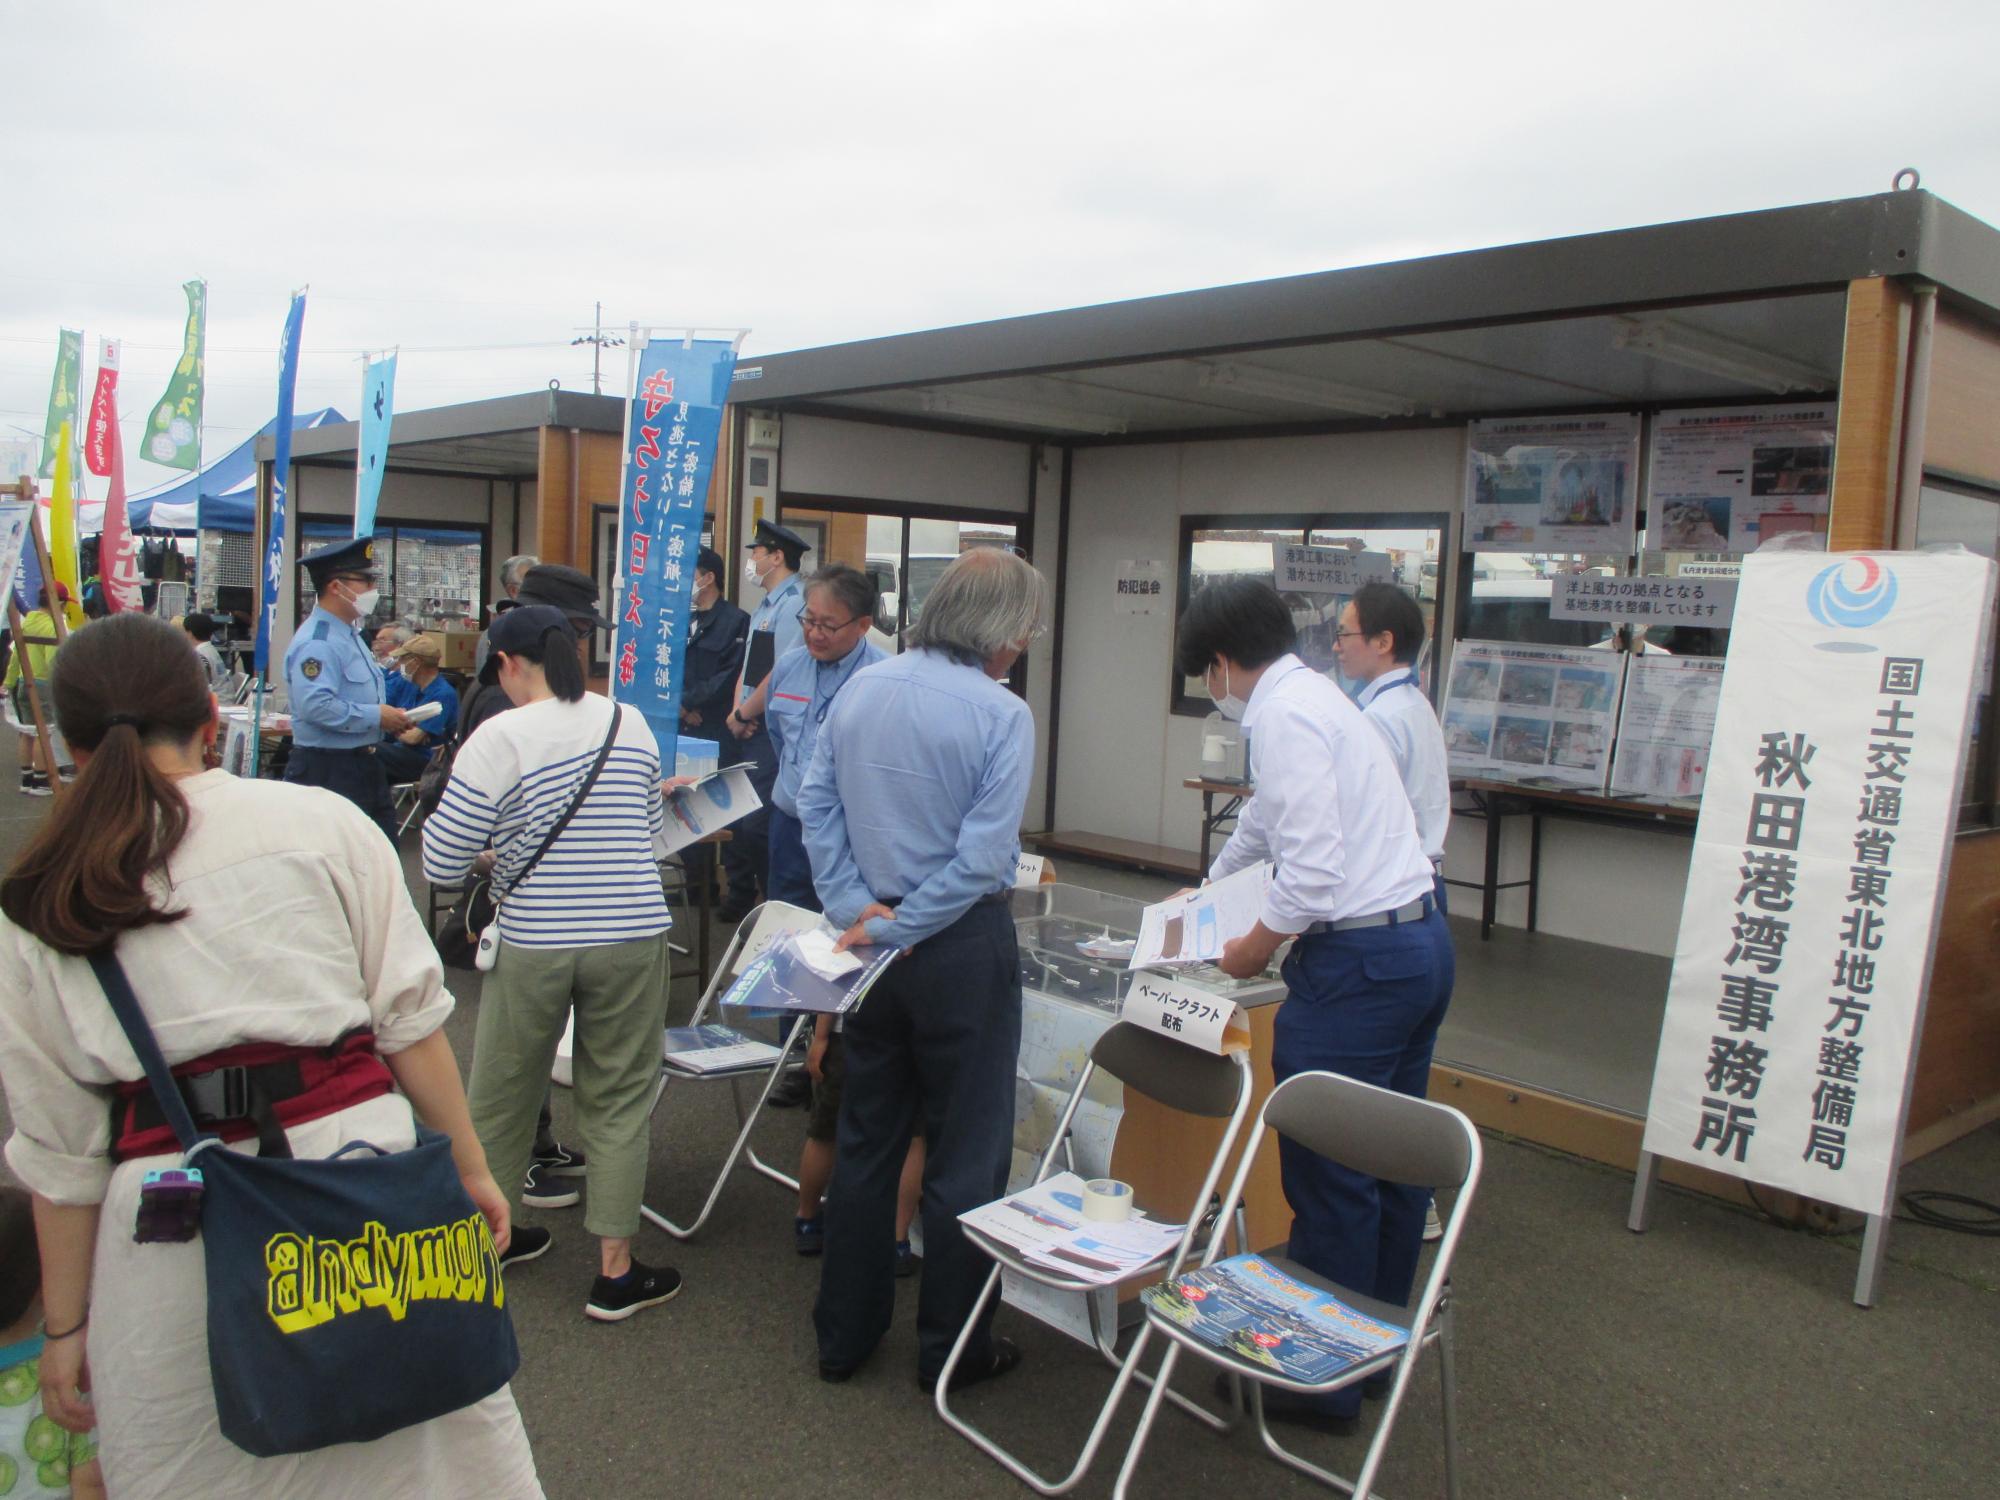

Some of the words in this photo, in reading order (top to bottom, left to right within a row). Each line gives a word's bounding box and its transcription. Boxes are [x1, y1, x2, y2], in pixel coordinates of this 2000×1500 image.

[1285, 548, 1358, 566] 港湾工事において
[1117, 579, 1161, 595] 防犯協会
[1565, 580, 1705, 599] 洋上風力の拠点となる
[1564, 598, 1718, 617] 基地港湾を整備しています
[1802, 656, 1923, 1171] 国土交通省東北地方整備局
[1692, 731, 1820, 1163] 秋田港湾事務所
[1139, 984, 1220, 1023] ペーパークラフト
[1161, 1012, 1183, 1032] 配布
